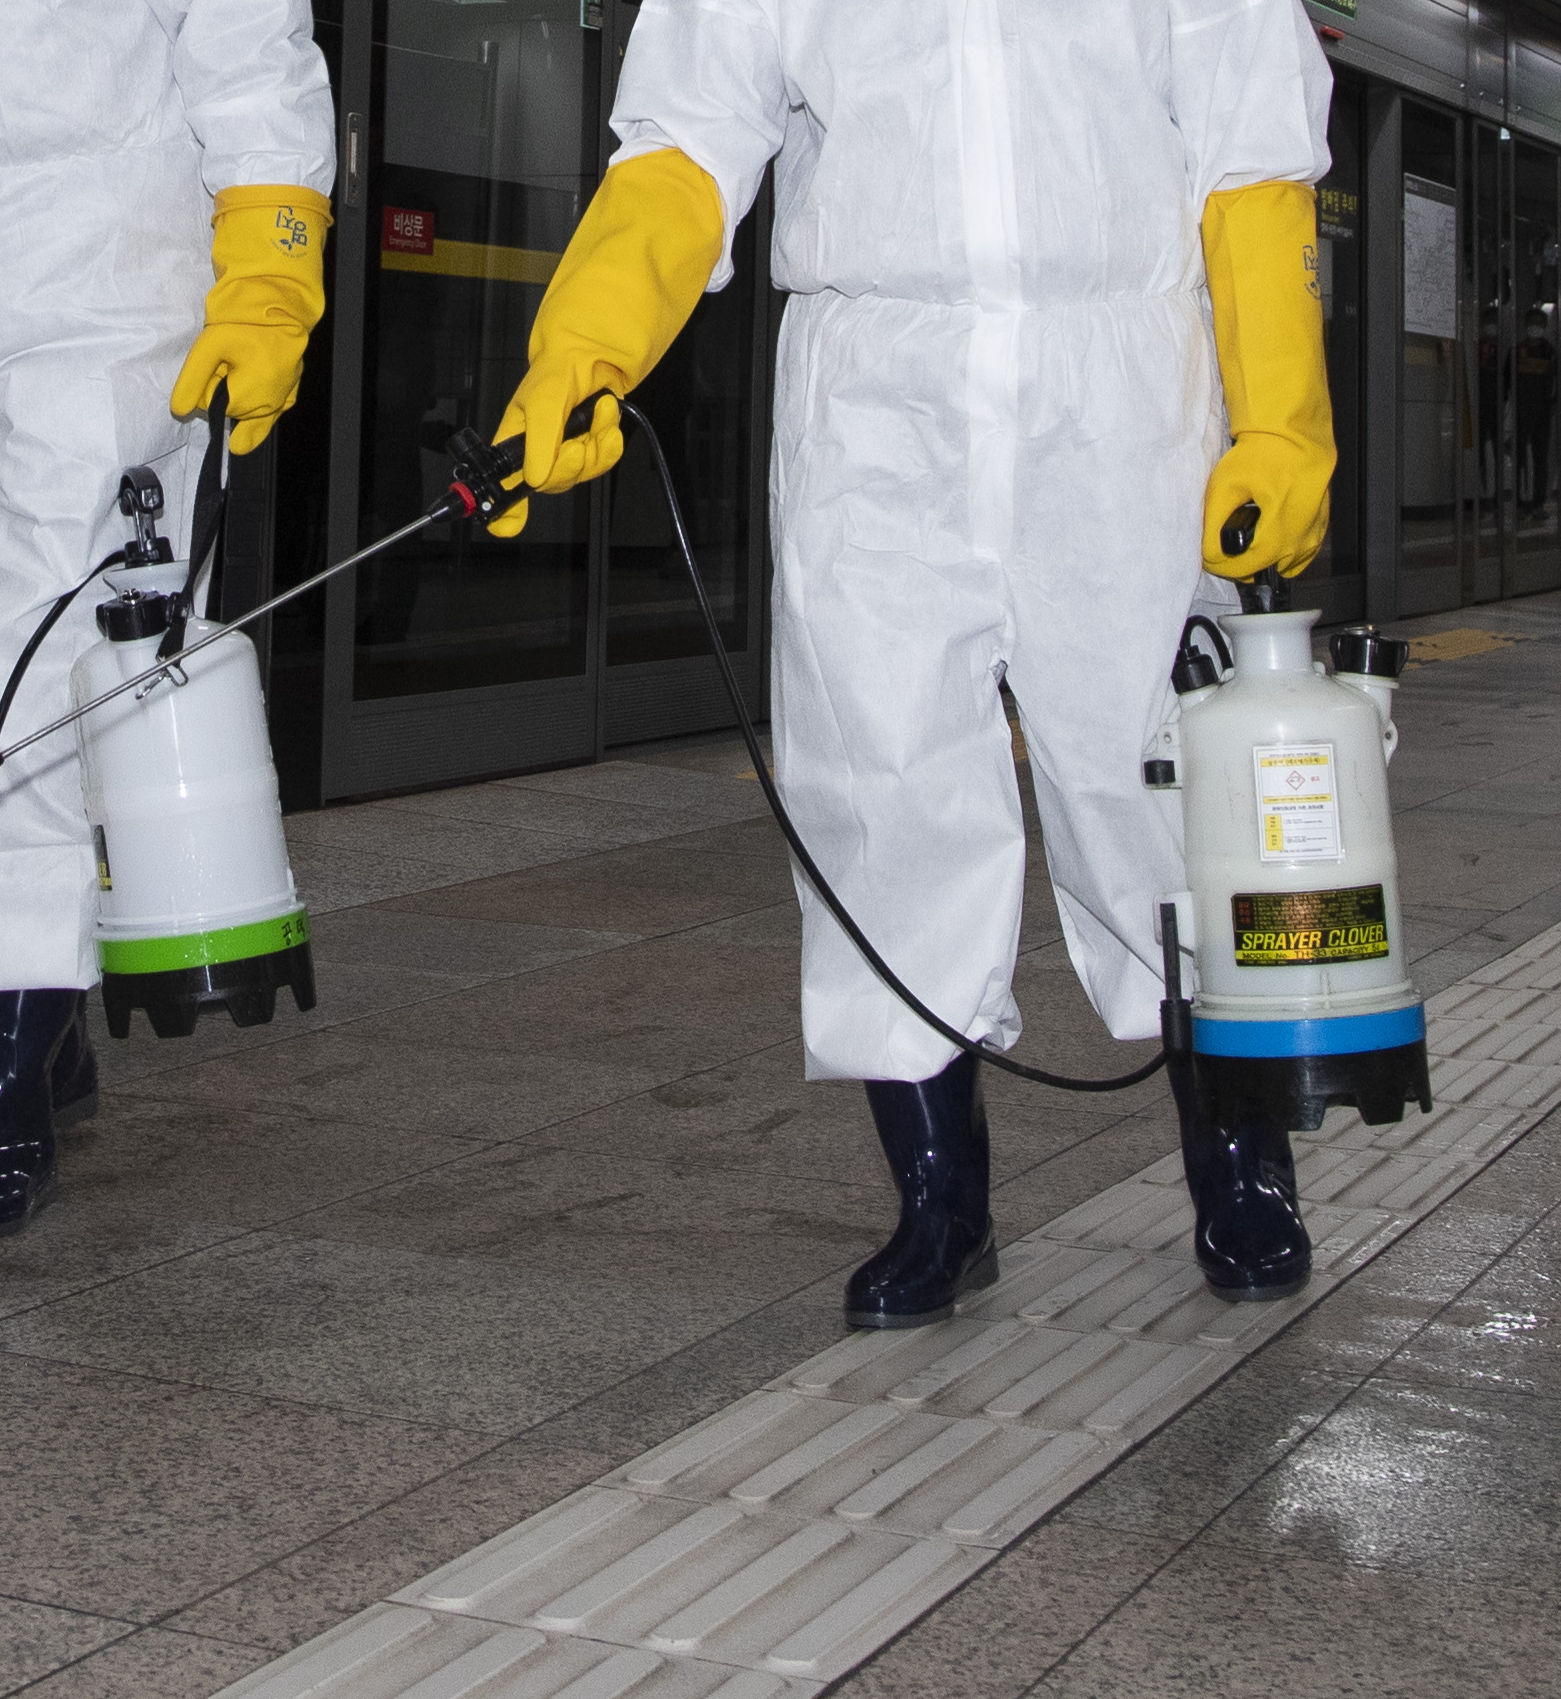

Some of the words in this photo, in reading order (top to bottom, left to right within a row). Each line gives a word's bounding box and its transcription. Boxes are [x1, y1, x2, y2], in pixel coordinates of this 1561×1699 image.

[393, 212, 424, 237] 비상문
[1242, 931, 1322, 950] SPRAYER
[1328, 925, 1384, 947] CLOVER
[1242, 950, 1274, 960] MODEL
